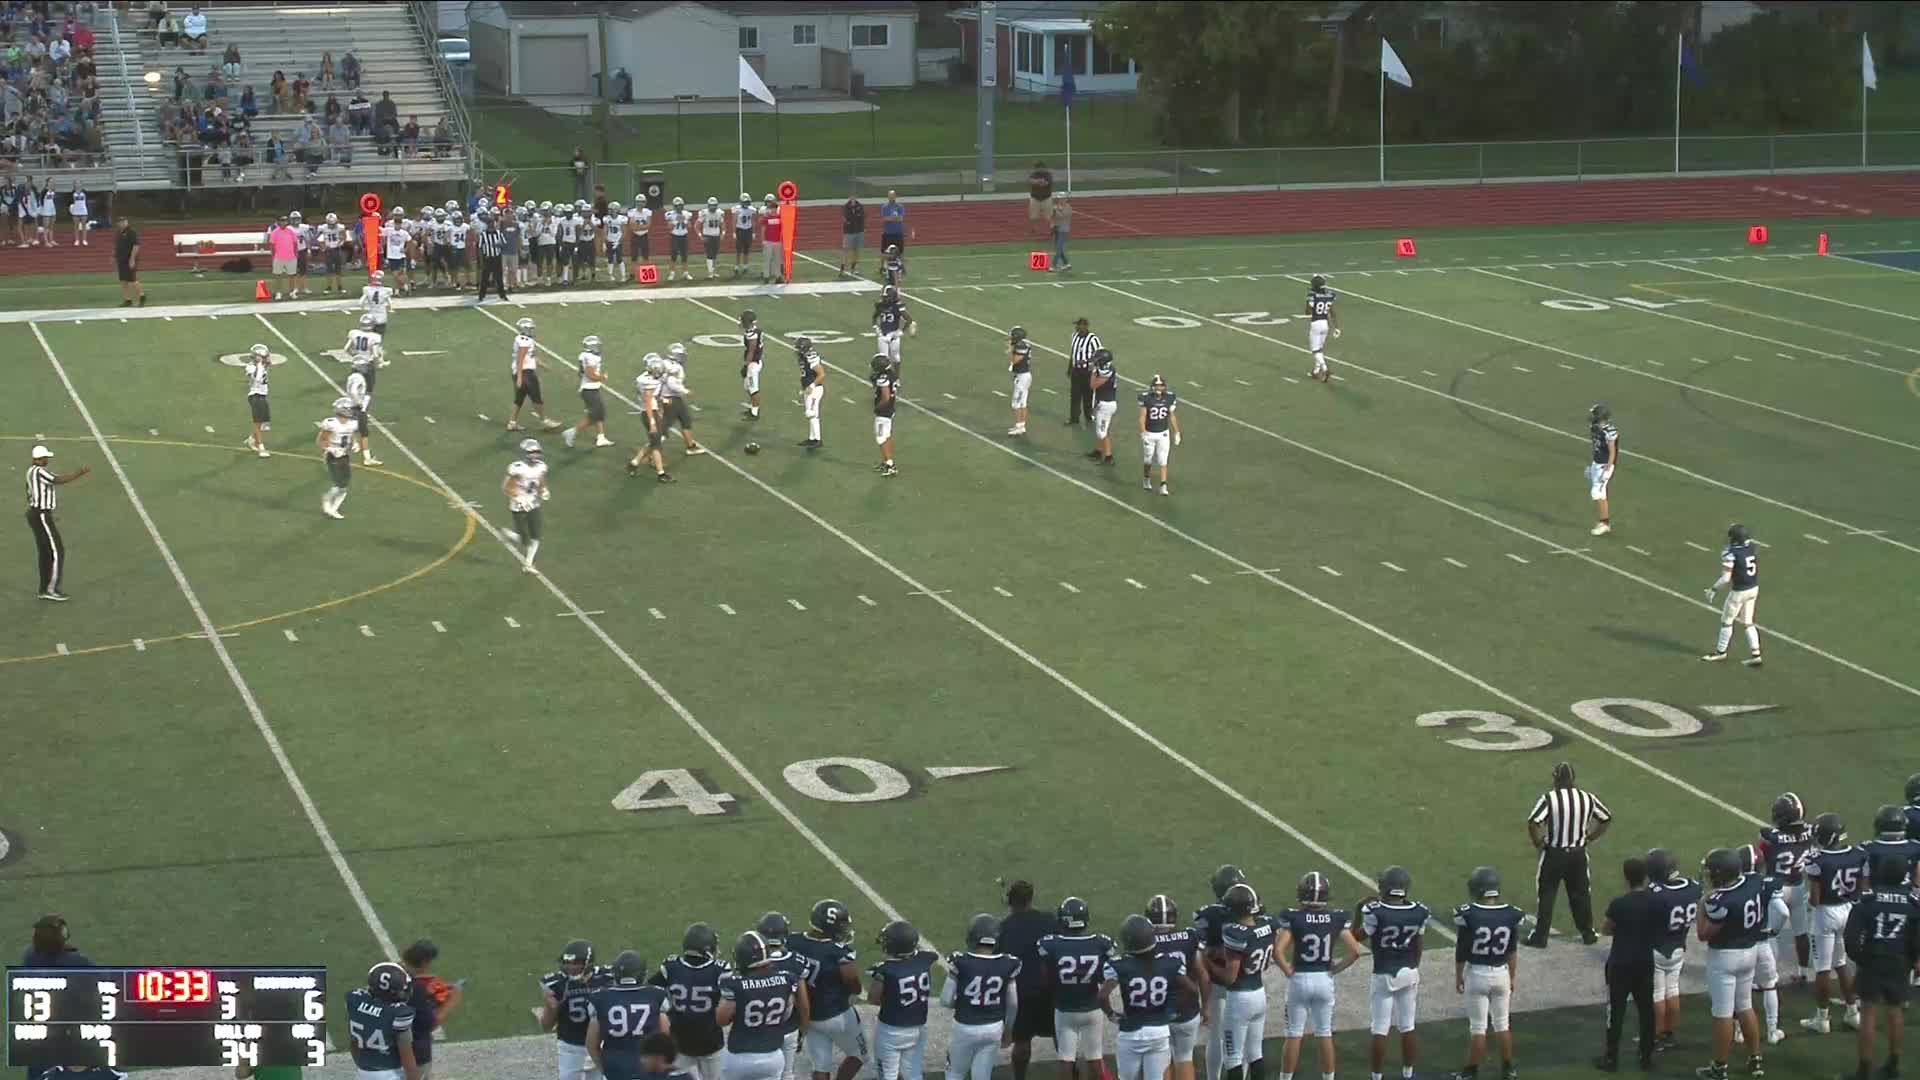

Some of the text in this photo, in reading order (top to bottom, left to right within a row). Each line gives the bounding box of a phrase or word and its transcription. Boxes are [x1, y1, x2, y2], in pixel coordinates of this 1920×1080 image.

[497, 186, 506, 204] 2
[642, 268, 656, 281] 30
[1033, 255, 1046, 268] 20
[374, 290, 380, 305] 4
[355, 335, 369, 351] 10
[1150, 407, 1168, 420] 26
[1745, 555, 1757, 576] 5
[1416, 697, 1703, 751] 30
[611, 756, 912, 815] 40
[1831, 867, 1861, 897] 45
[1743, 893, 1763, 929] 61
[1876, 892, 1908, 904] SMITH
[826, 907, 839, 924] S
[1305, 913, 1332, 924] OLDS
[1669, 902, 1698, 931] 68
[1873, 911, 1907, 940] 17
[1300, 933, 1331, 963] 31
[1380, 924, 1420, 949] 27
[1472, 926, 1511, 956] 23
[1057, 954, 1100, 985] 27
[1246, 943, 1275, 975] 30
[378, 972, 390, 990] S
[742, 975, 787, 990] HARRISON
[898, 971, 931, 1007] 59
[963, 975, 1004, 1007] 42
[1128, 976, 1169, 1008] 28
[669, 984, 713, 1013] 25
[743, 997, 787, 1028] 62
[607, 1003, 651, 1038] 97
[349, 1019, 390, 1055] 54
